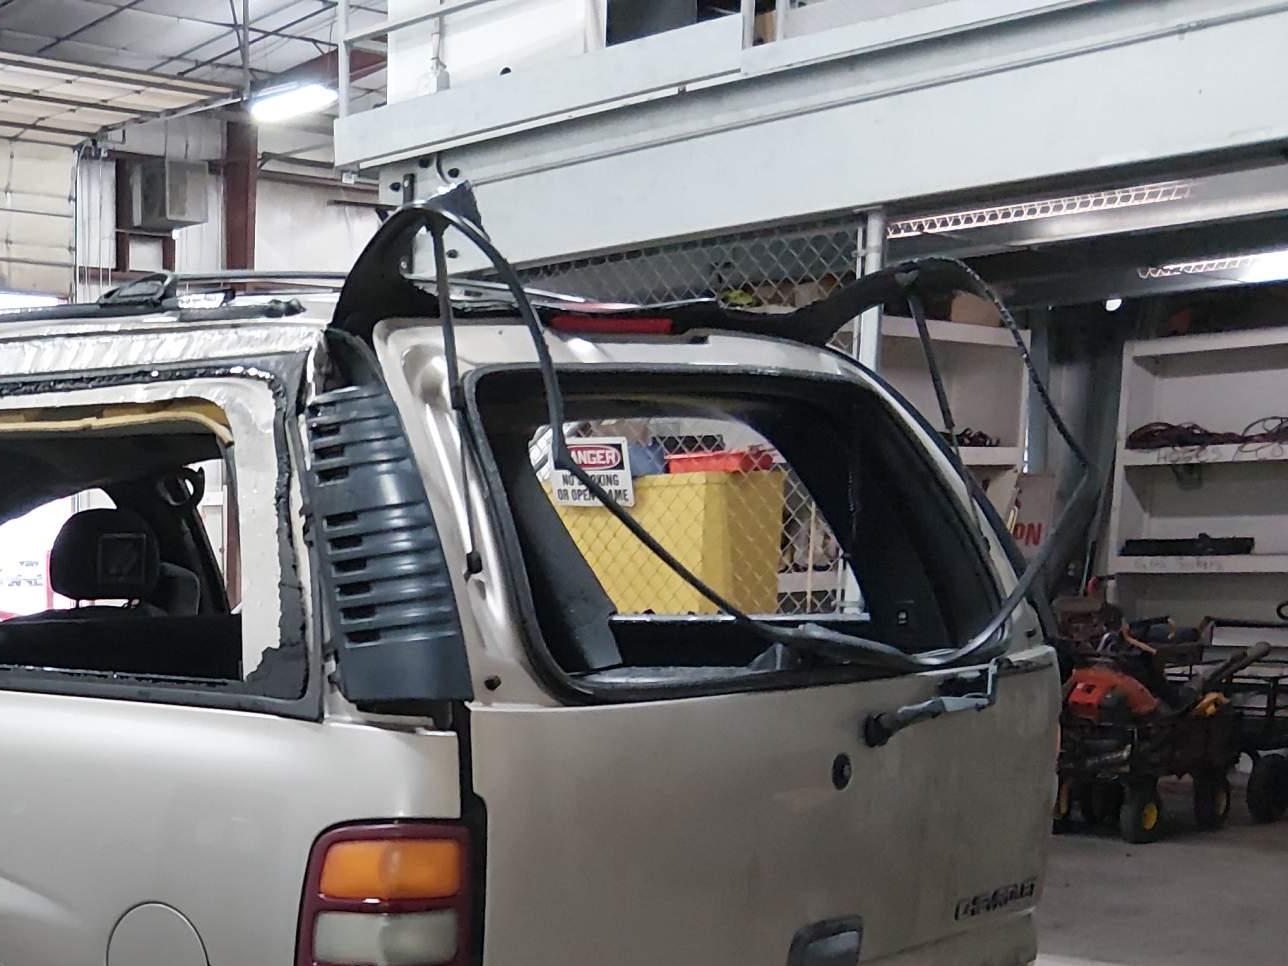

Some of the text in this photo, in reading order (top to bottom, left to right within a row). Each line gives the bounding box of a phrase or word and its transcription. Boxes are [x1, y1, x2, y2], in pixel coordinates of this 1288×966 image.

[569, 448, 616, 465] ANGER
[562, 474, 620, 486] NO OKING
[557, 488, 570, 500] OR
[607, 488, 629, 502] AME
